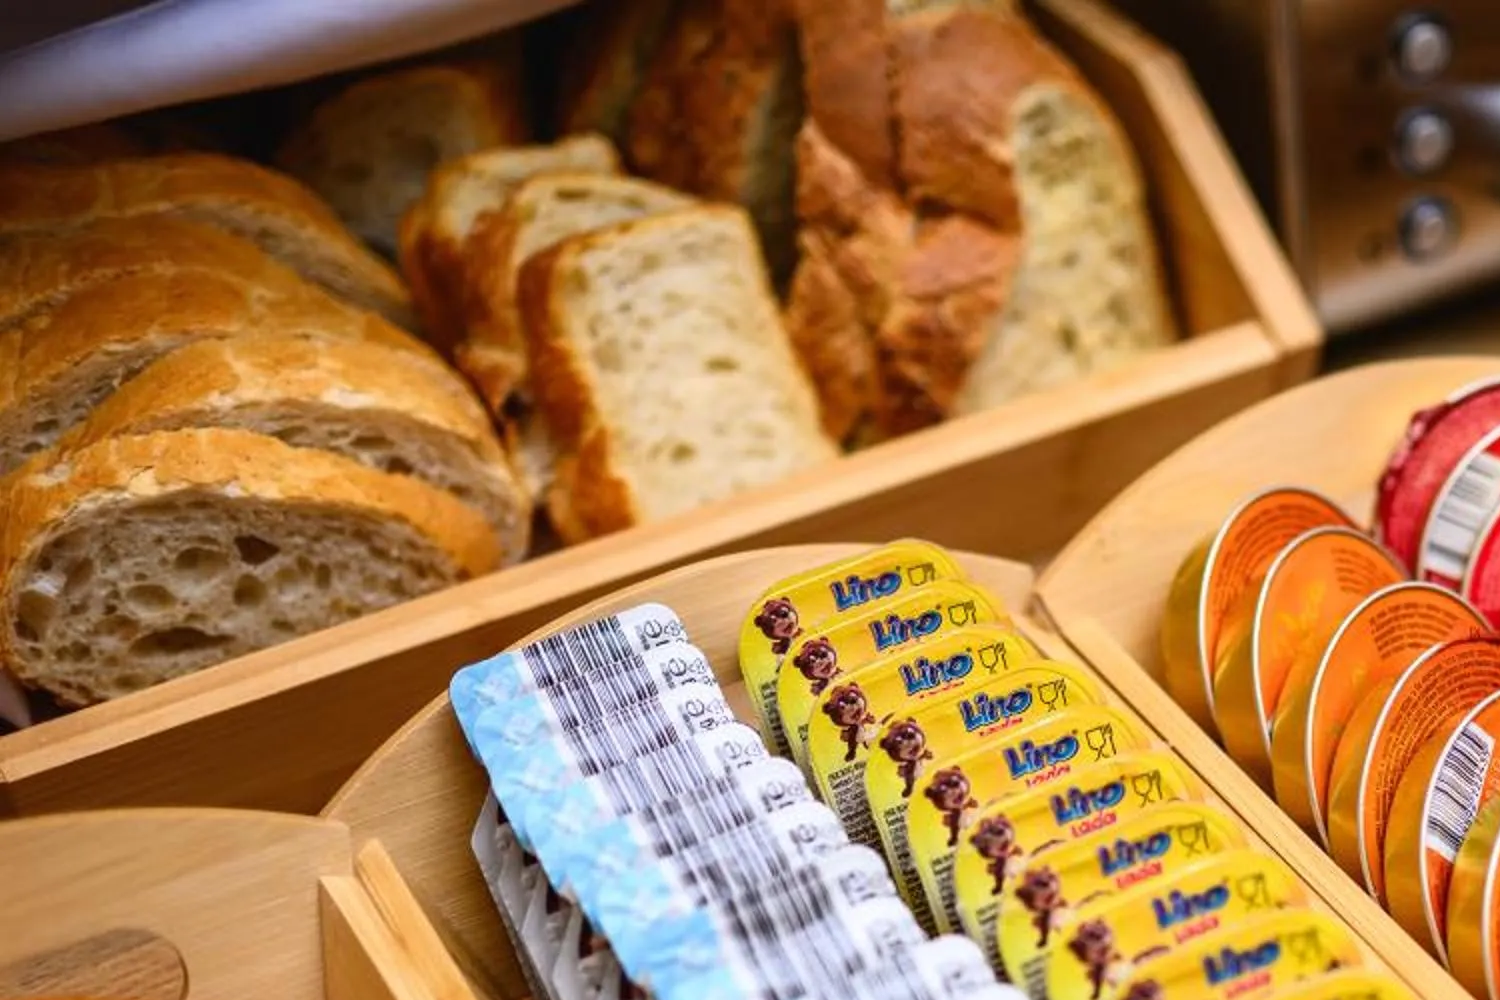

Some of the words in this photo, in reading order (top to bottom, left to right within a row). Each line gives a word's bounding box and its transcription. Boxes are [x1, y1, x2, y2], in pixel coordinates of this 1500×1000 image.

[830, 572, 902, 612] Lino
[869, 610, 942, 651] Lino
[899, 653, 974, 696] Lino
[959, 688, 1033, 732] Lino
[1003, 735, 1079, 780] Lino
[1051, 781, 1126, 826] Lino
[1097, 831, 1172, 876] Lino
[1152, 884, 1230, 929] Lino
